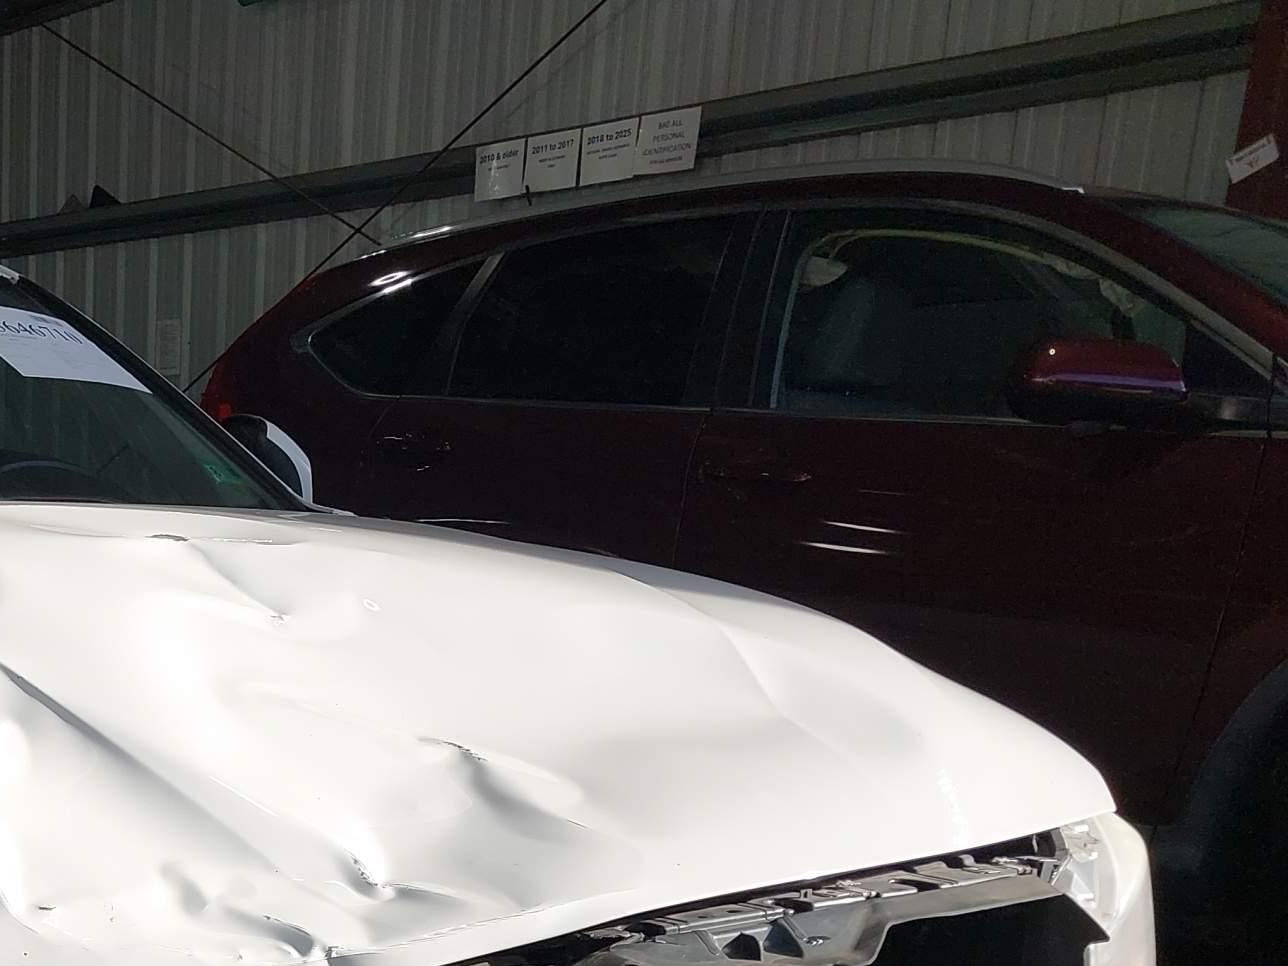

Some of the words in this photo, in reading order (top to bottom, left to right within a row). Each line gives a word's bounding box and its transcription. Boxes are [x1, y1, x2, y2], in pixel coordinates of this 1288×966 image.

[671, 119, 683, 127] ALL
[587, 134, 604, 146] 2018
[606, 133, 614, 141] to
[532, 144, 548, 155] 2011
[549, 143, 557, 151] to
[558, 138, 574, 150] 2017
[496, 152, 502, 161] &
